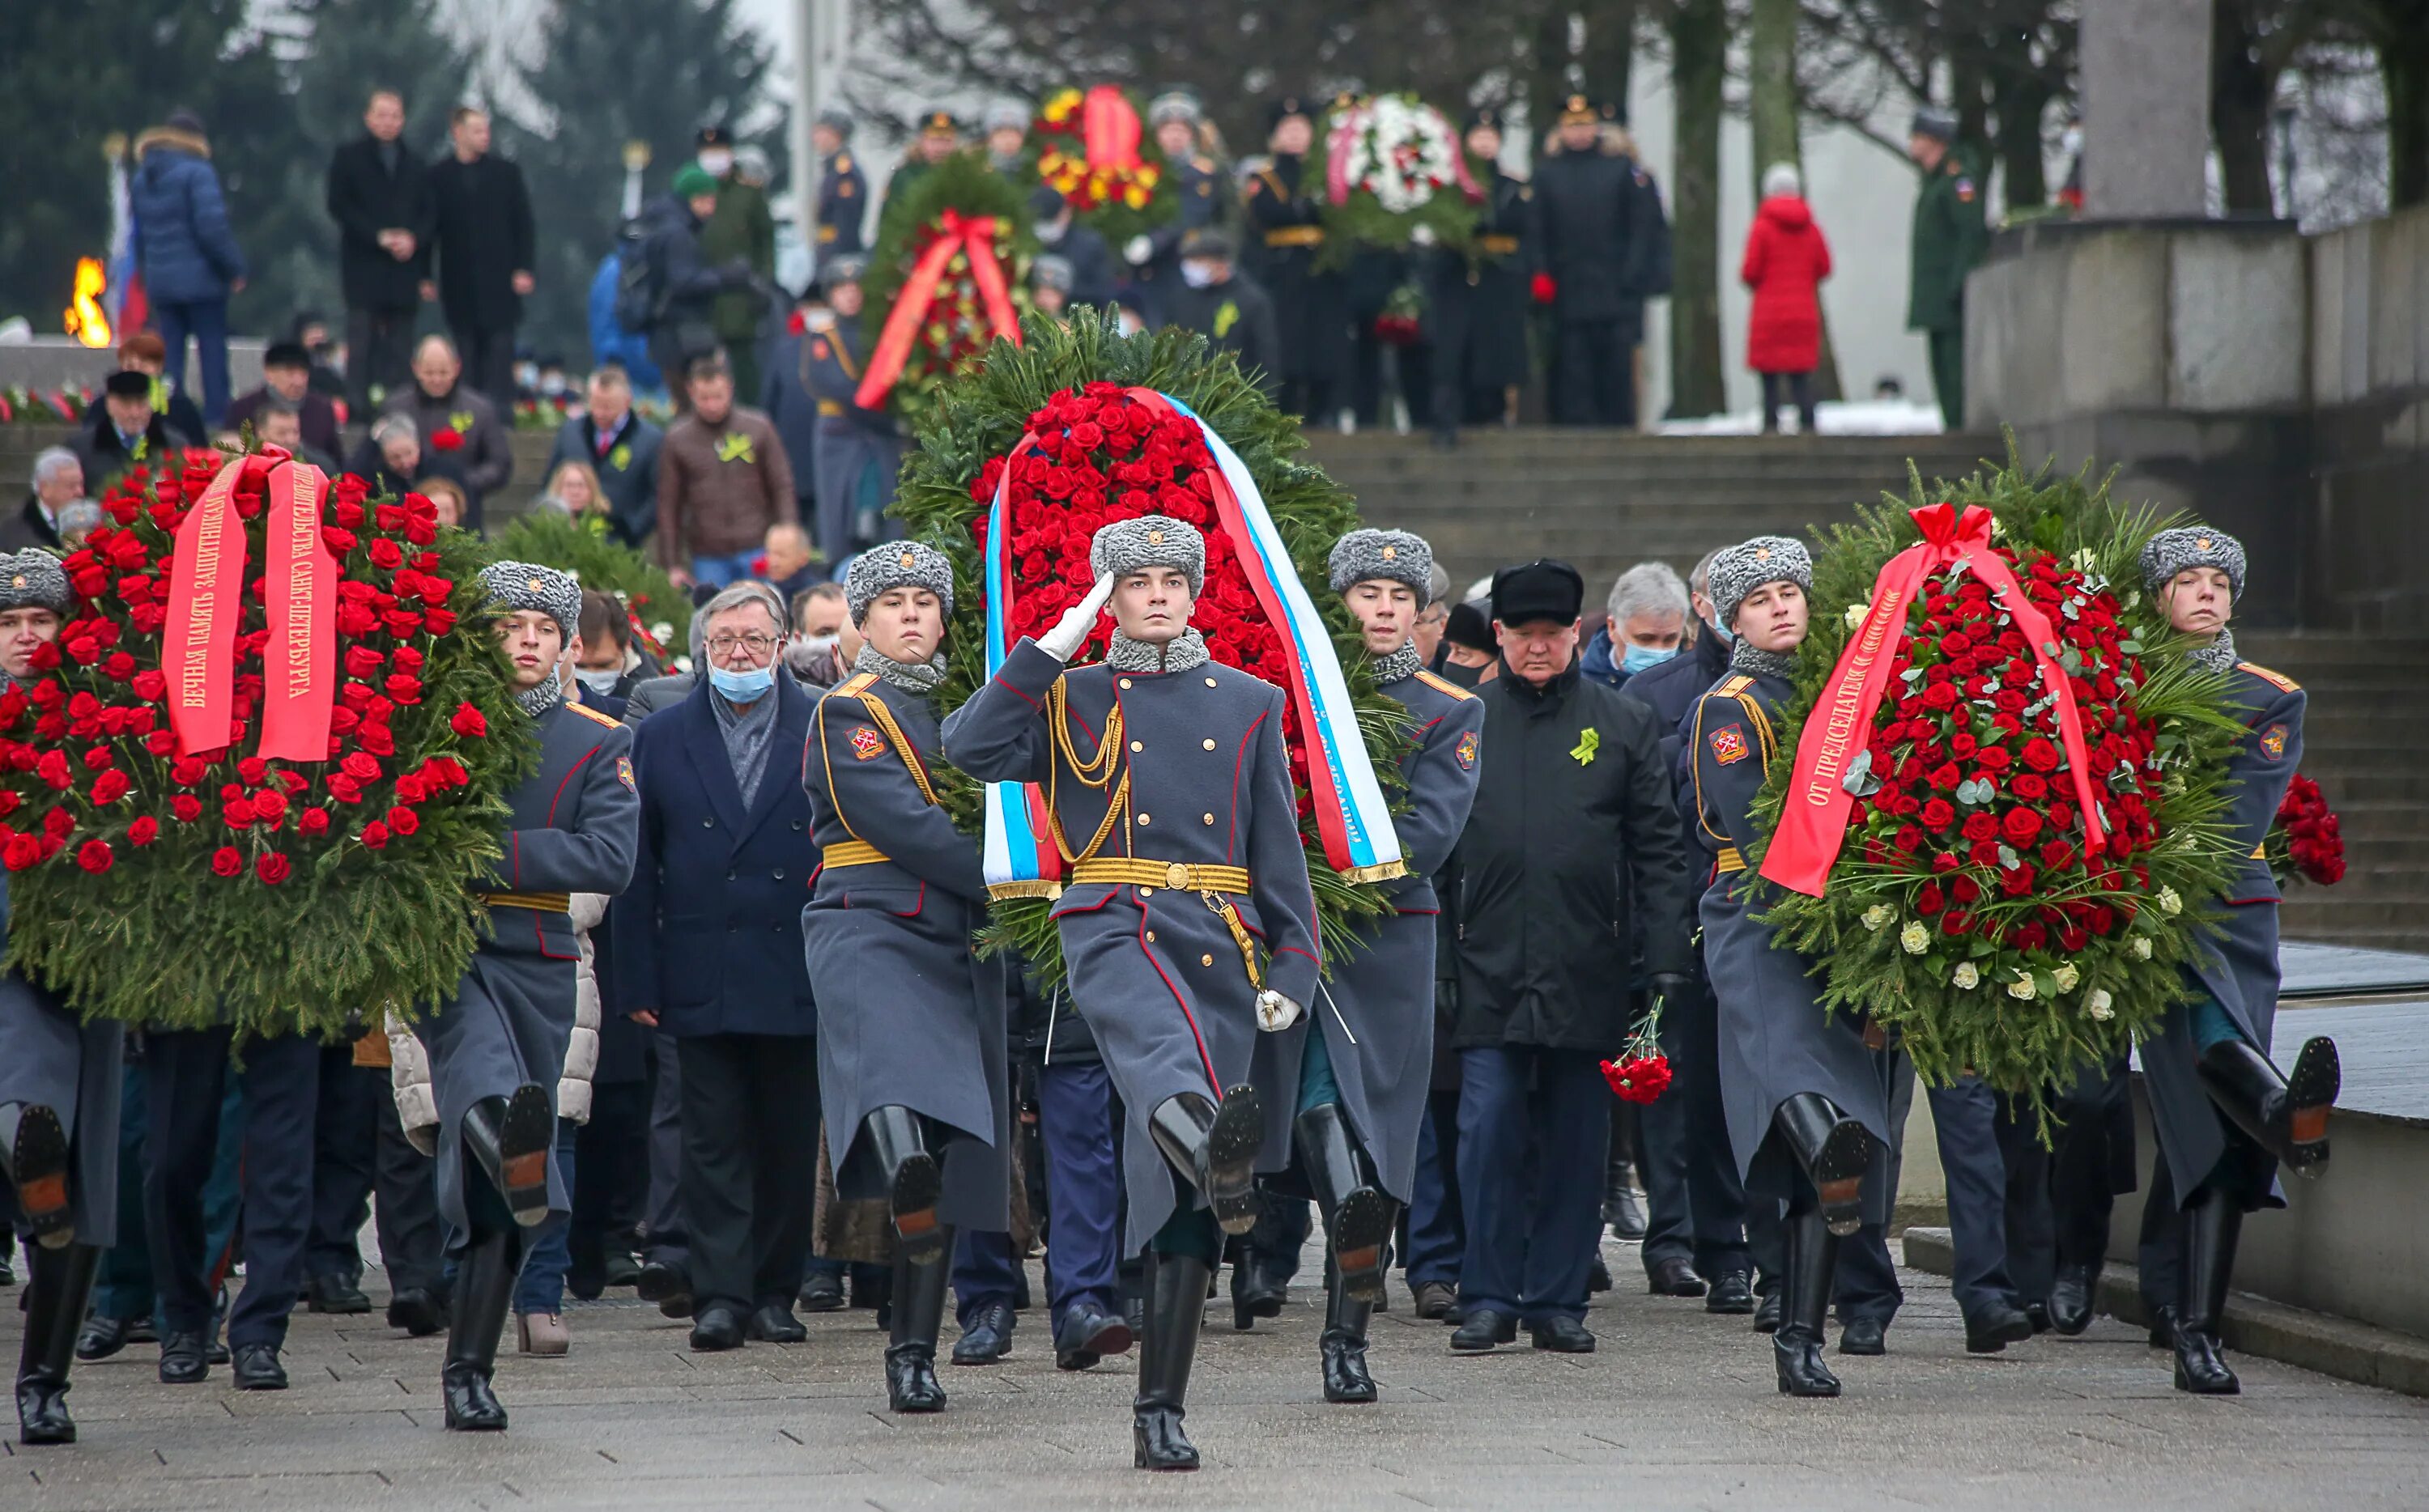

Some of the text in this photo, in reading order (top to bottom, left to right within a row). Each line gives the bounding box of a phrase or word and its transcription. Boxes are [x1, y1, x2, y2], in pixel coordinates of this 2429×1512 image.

[182, 495, 226, 708] ВЕЧНАЯ ПАМЯТЬ ЗАЩИТНИКАМ
[288, 468, 316, 699] ПРАВИТЕЛЬСТВА САНКТ-ПЕТЕРБУРГА
[1852, 654, 1874, 666] И
[1814, 667, 1868, 779] ПРЕДСЕДАТЕЛЯ
[1806, 781, 1831, 806] ОТ
